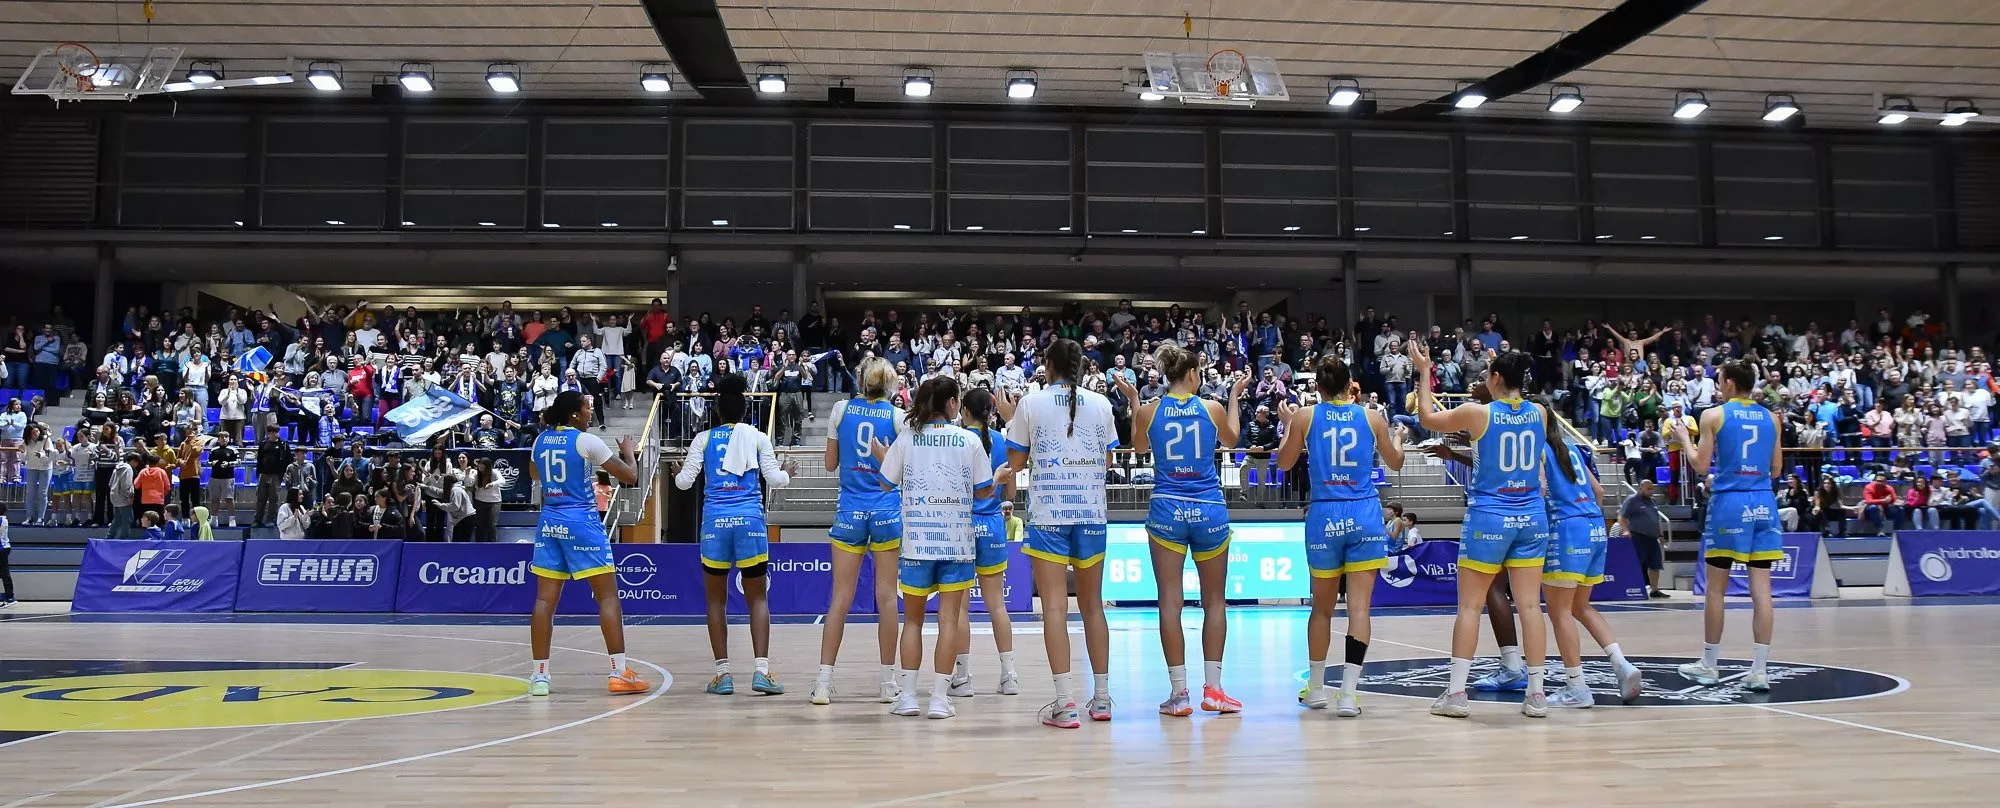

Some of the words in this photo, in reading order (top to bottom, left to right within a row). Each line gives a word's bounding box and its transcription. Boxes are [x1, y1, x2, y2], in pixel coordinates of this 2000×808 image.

[1054, 394, 1084, 406] MAA
[1326, 410, 1353, 421] SOLER
[1733, 409, 1763, 420] PALMA
[542, 435, 568, 445] BAINES
[856, 421, 874, 457] 9
[1164, 420, 1201, 460] 21
[1742, 424, 1758, 459] 7
[1323, 426, 1358, 467] 12
[1499, 430, 1536, 471] 00
[539, 449, 567, 483] 15
[1061, 457, 1096, 465] CaixaBank
[1175, 465, 1194, 474] Pujol
[1331, 473, 1350, 482] Pujol
[1507, 480, 1526, 488] Pujol
[928, 495, 960, 504] CaixaBank
[1482, 533, 1503, 541] PEUSA
[261, 558, 375, 581] EFAUSA
[418, 560, 526, 585] Creand
[1420, 563, 1445, 576] Vilà
[1447, 562, 1458, 575] B
